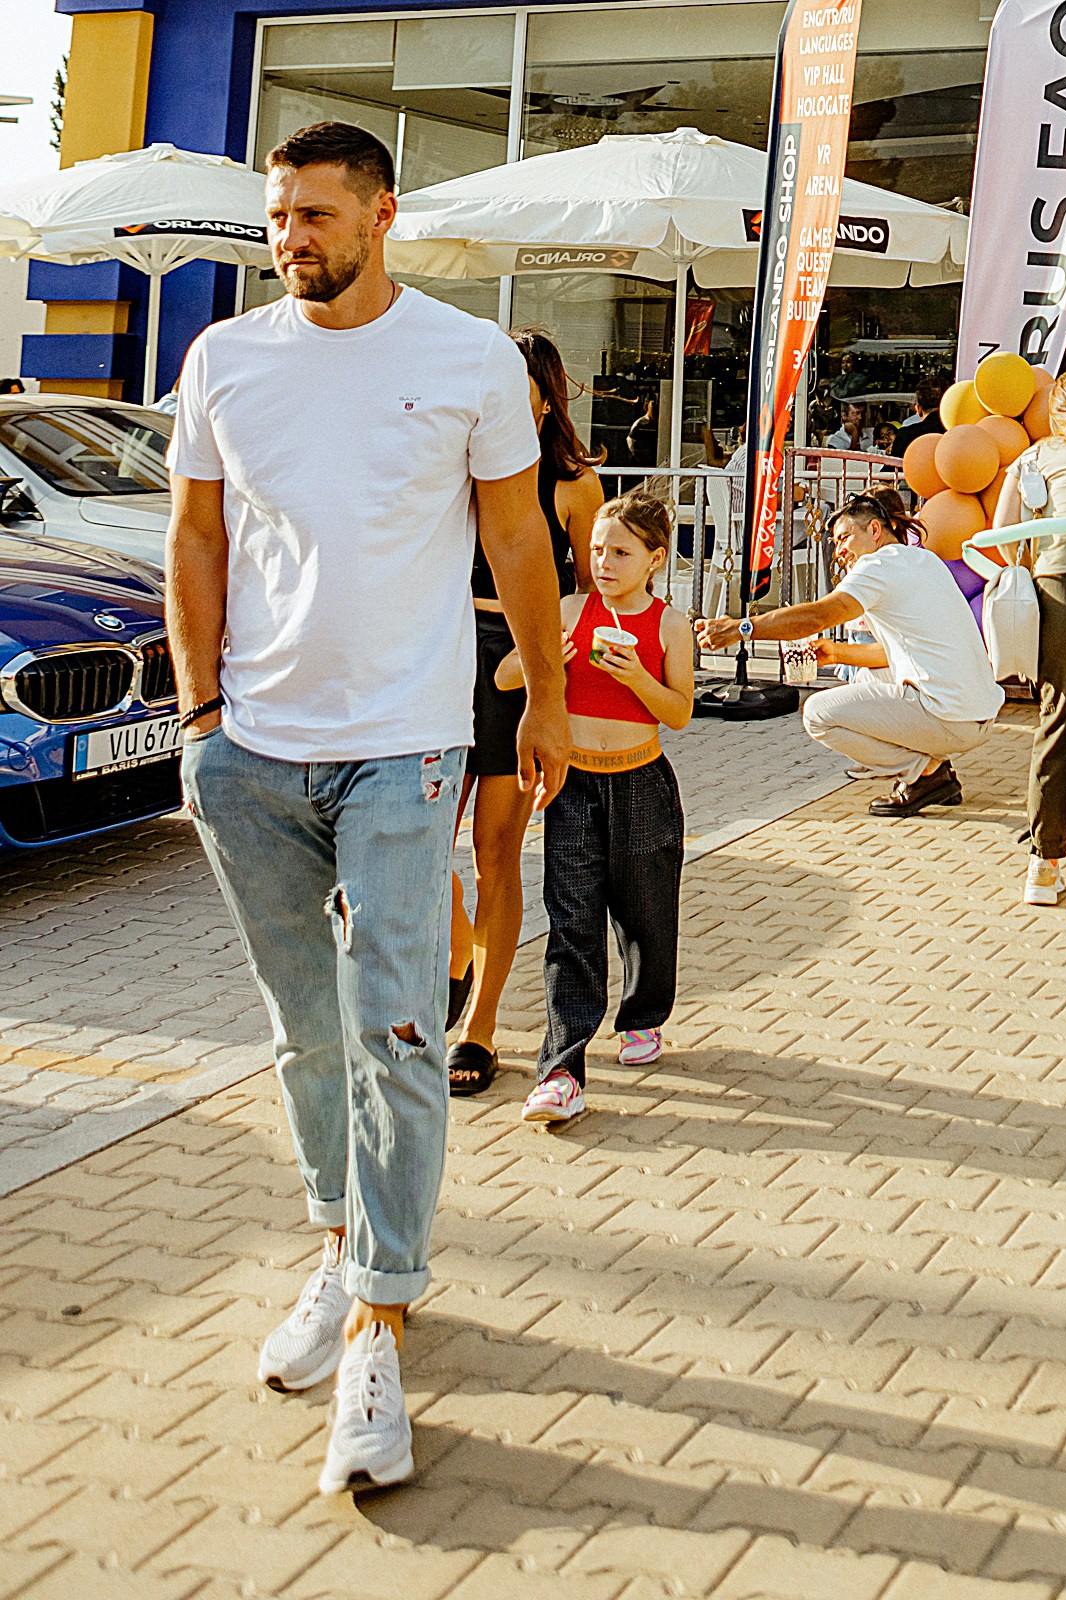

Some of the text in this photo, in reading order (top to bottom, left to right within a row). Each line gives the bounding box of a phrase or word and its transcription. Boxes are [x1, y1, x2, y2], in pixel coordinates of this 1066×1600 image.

[802, 5, 855, 28] ENG/TR/RU
[799, 33, 854, 55] LANGUAGES
[803, 64, 845, 86] VIP HALL
[796, 94, 849, 117] HOLOGATE
[817, 144, 831, 164] VR
[805, 175, 839, 196] ARENA
[153, 220, 263, 238] ORLANDO
[799, 227, 833, 248] GAMES
[765, 134, 797, 393] ORLANDO SHOP
[110, 728, 138, 760] VU
[144, 718, 181, 752] 677
